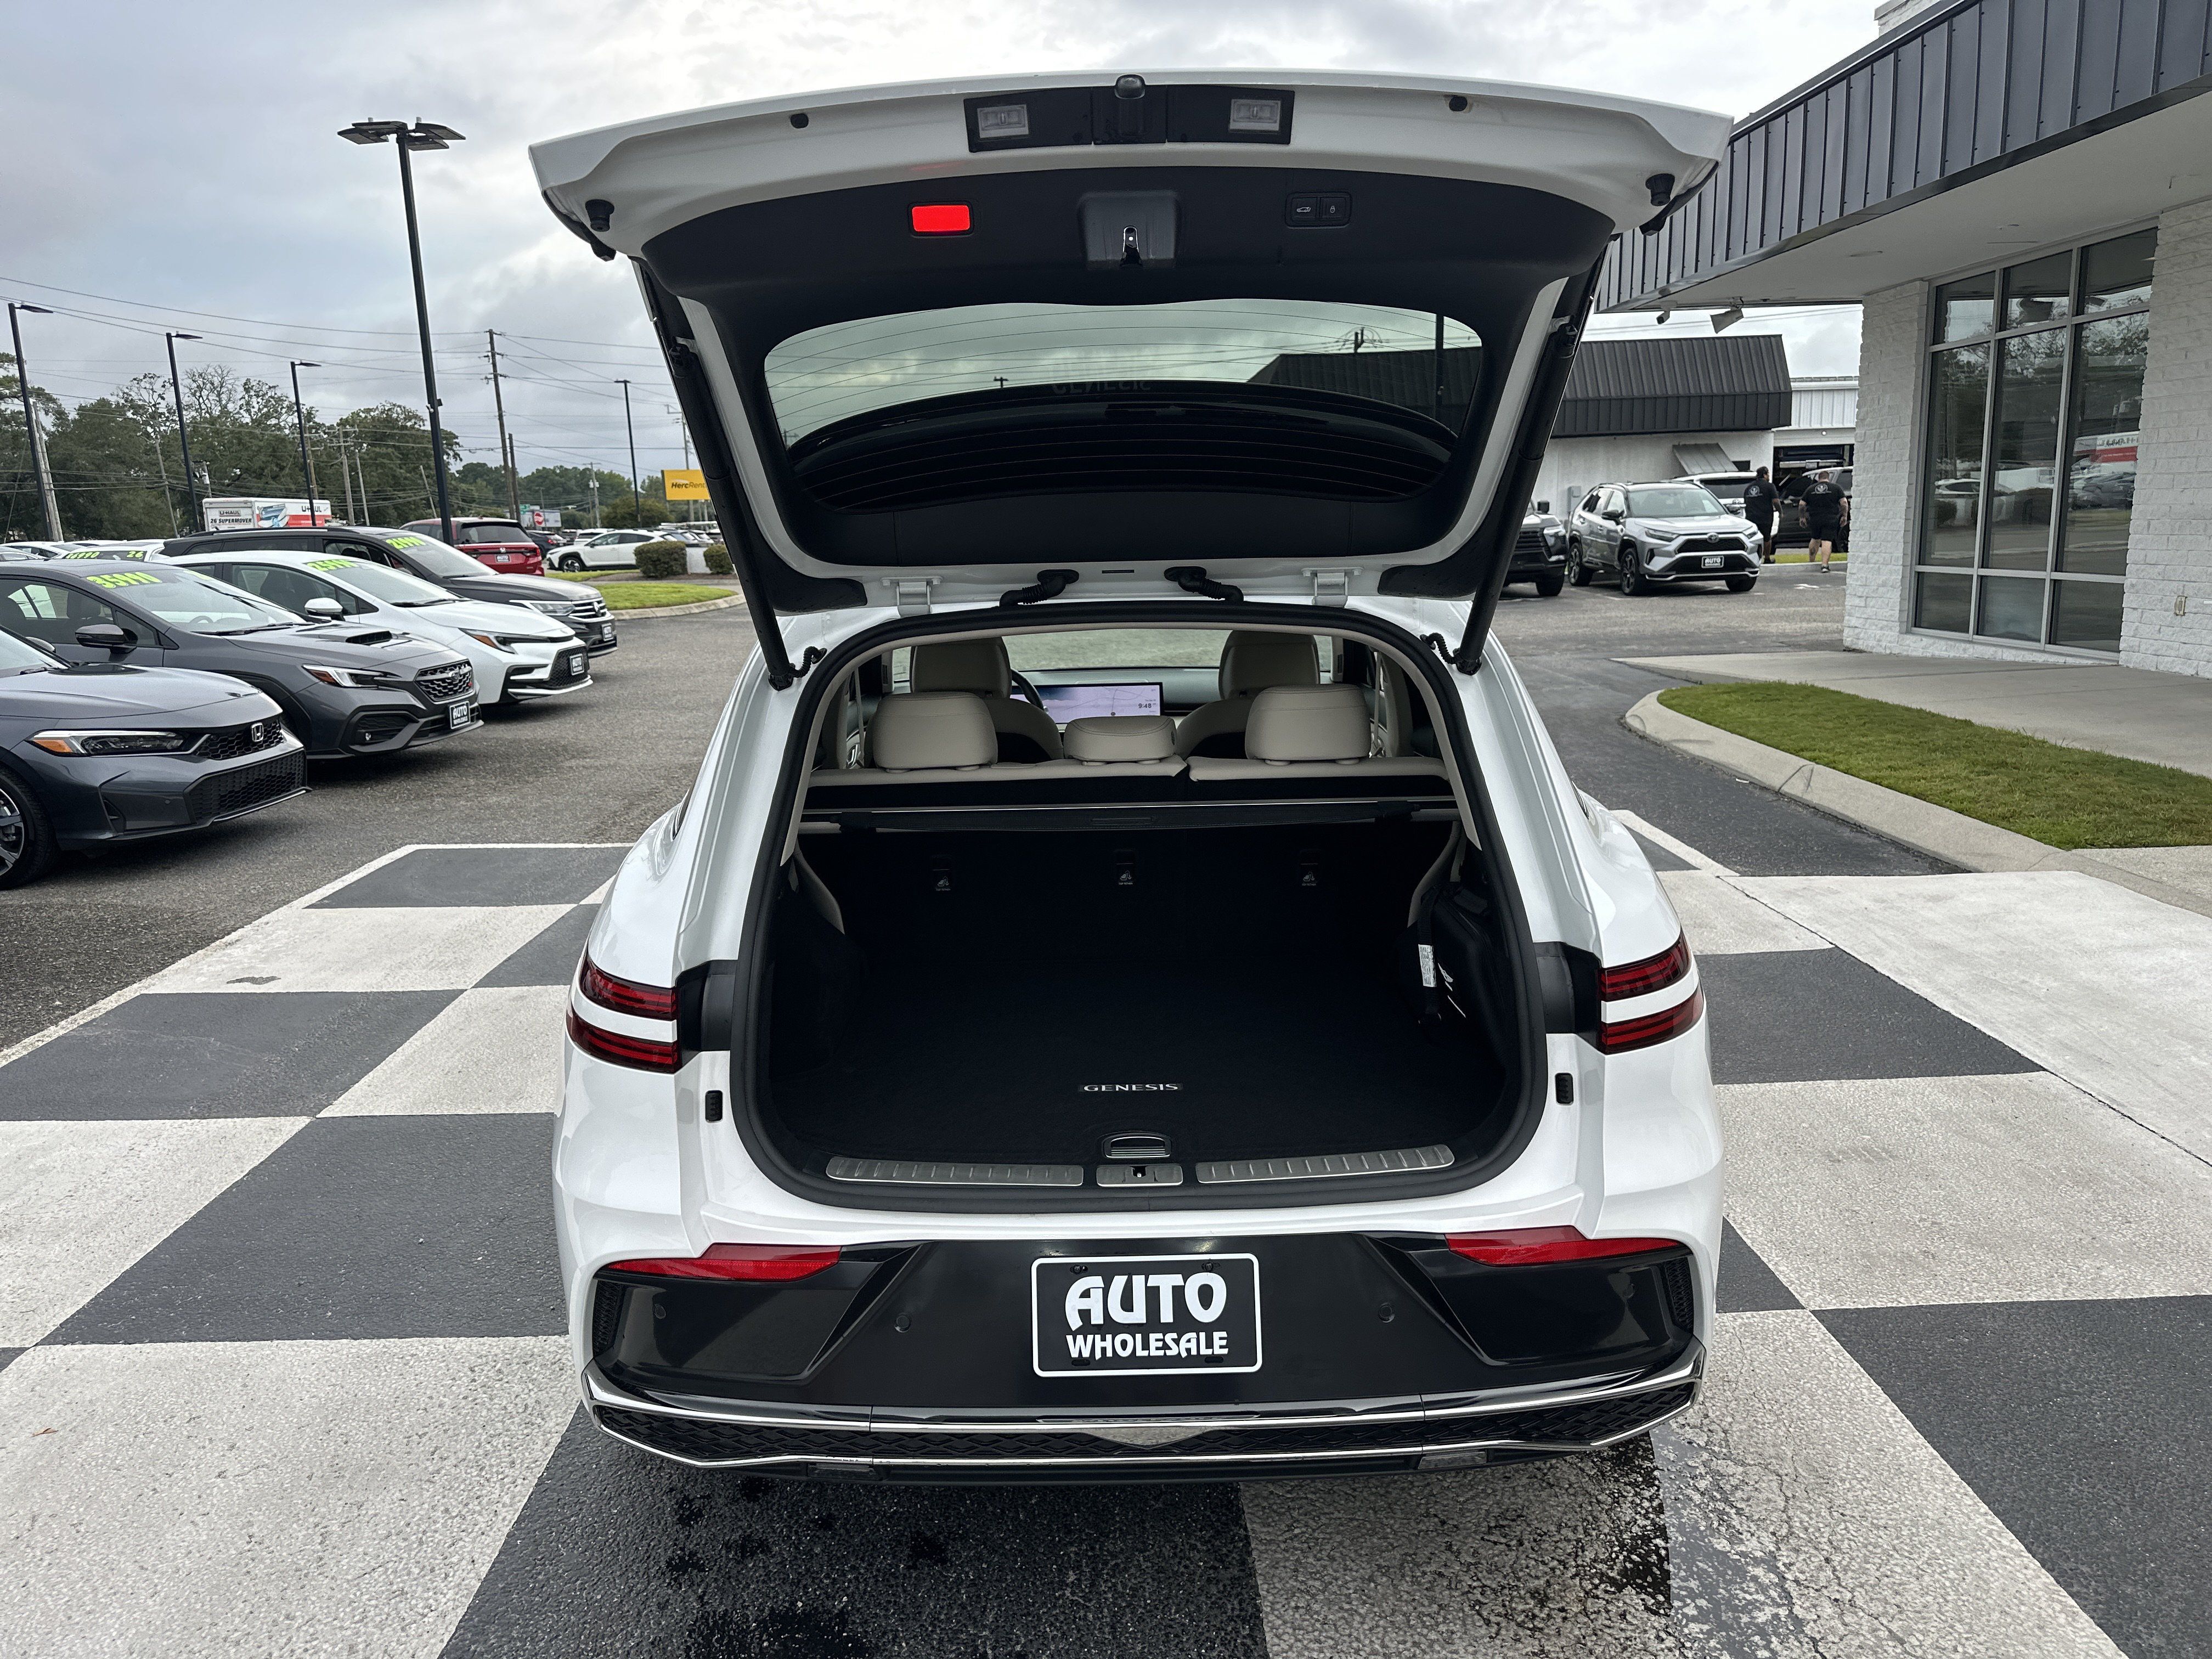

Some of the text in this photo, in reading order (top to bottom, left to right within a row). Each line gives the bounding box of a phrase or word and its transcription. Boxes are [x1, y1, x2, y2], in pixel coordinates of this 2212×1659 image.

[87, 572, 163, 589] 35990
[453, 706, 467, 719] AUTO
[1084, 1084, 1178, 1092] GENESIS
[1065, 1272, 1227, 1331] AUTO
[1065, 1331, 1229, 1361] WHOLESALE
